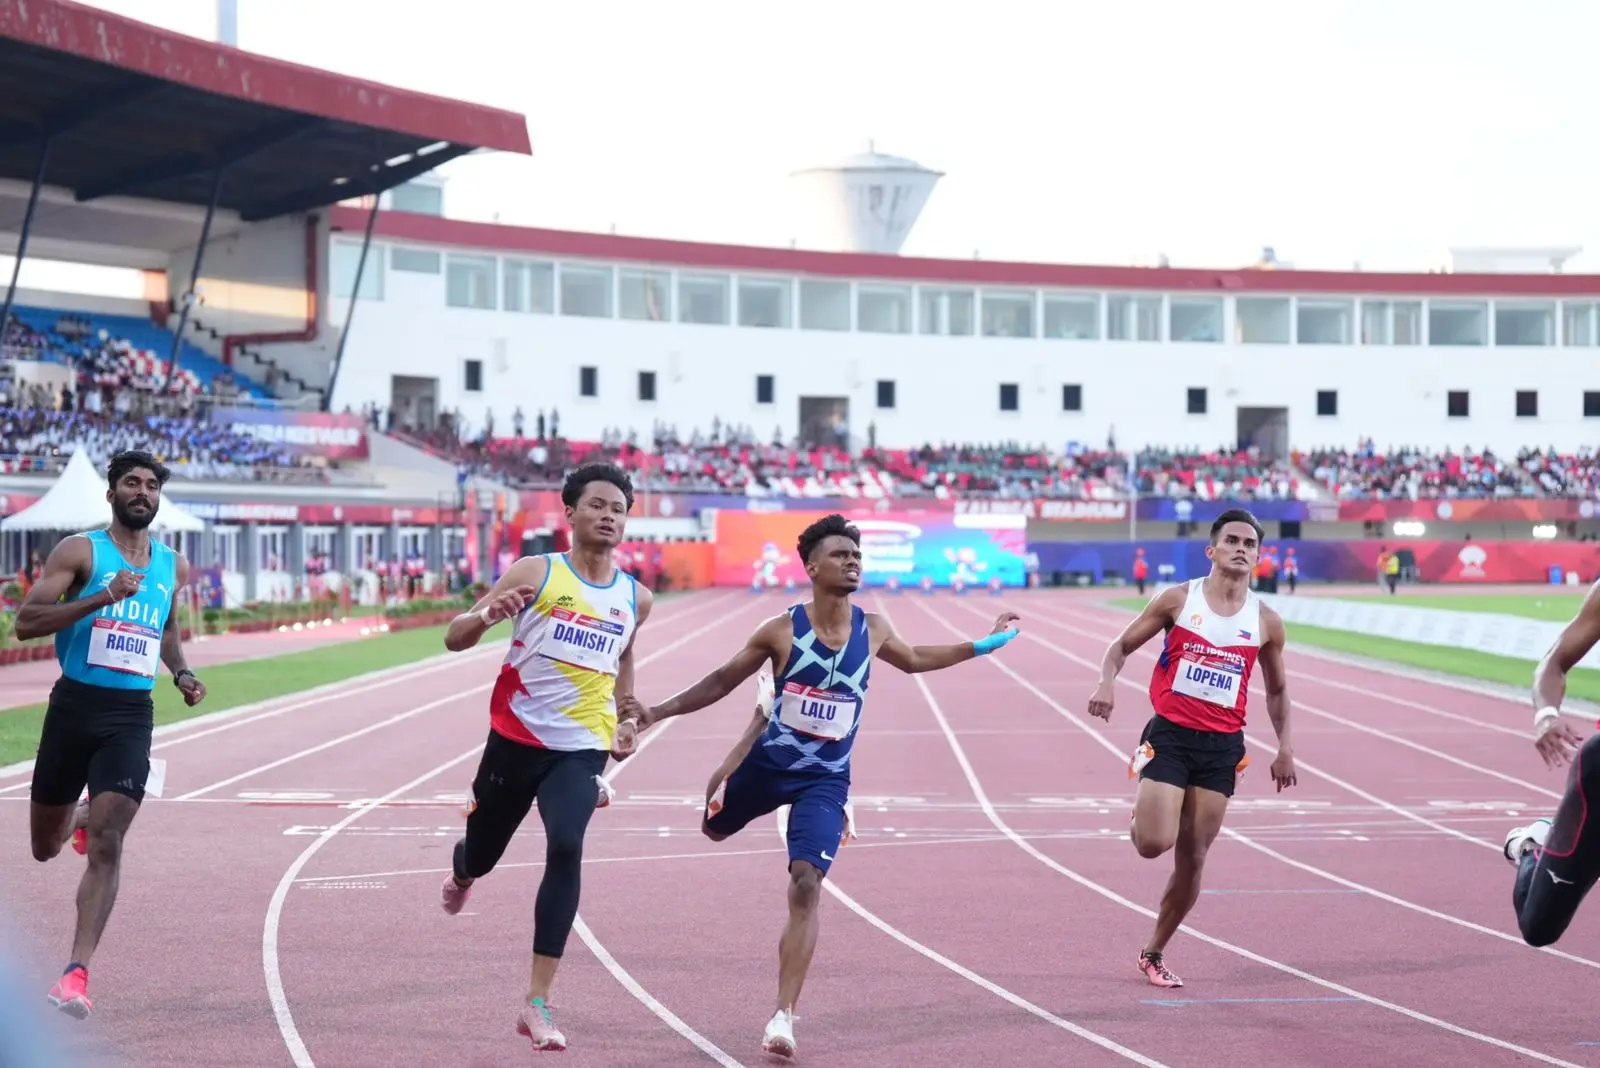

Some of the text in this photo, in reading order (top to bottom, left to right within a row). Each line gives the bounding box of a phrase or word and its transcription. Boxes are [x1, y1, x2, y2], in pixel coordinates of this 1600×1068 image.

[101, 598, 159, 629] INDIA
[105, 633, 148, 656] RAGUL
[553, 623, 615, 654] DANISH I
[1185, 664, 1233, 691] LOPENA
[800, 699, 837, 720] LALU
